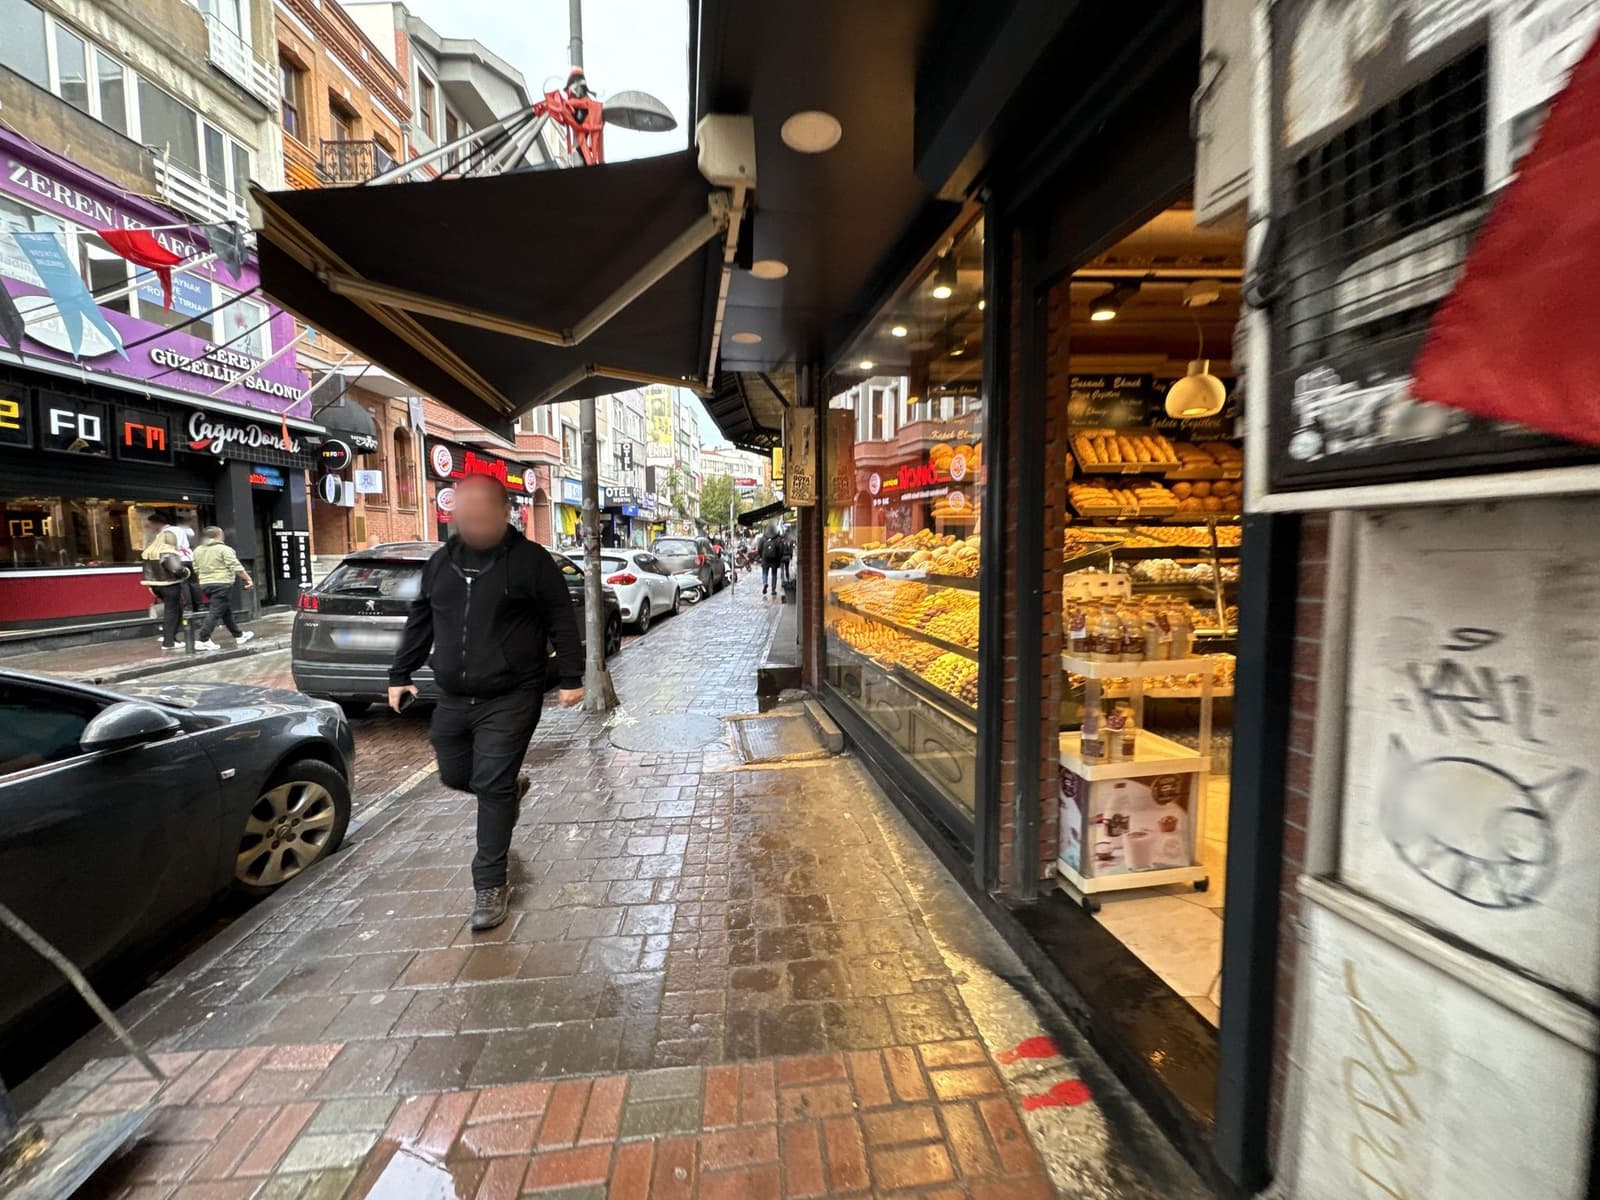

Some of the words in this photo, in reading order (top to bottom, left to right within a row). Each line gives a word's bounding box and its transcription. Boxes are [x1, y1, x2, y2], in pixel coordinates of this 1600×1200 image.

[8, 161, 113, 226] ZEREN
[205, 344, 260, 374] ZEREN
[150, 348, 241, 386] GÜZELLİK
[245, 376, 302, 401] SALONU
[622, 443, 632, 471] OTEL
[606, 487, 631, 497] OTEL
